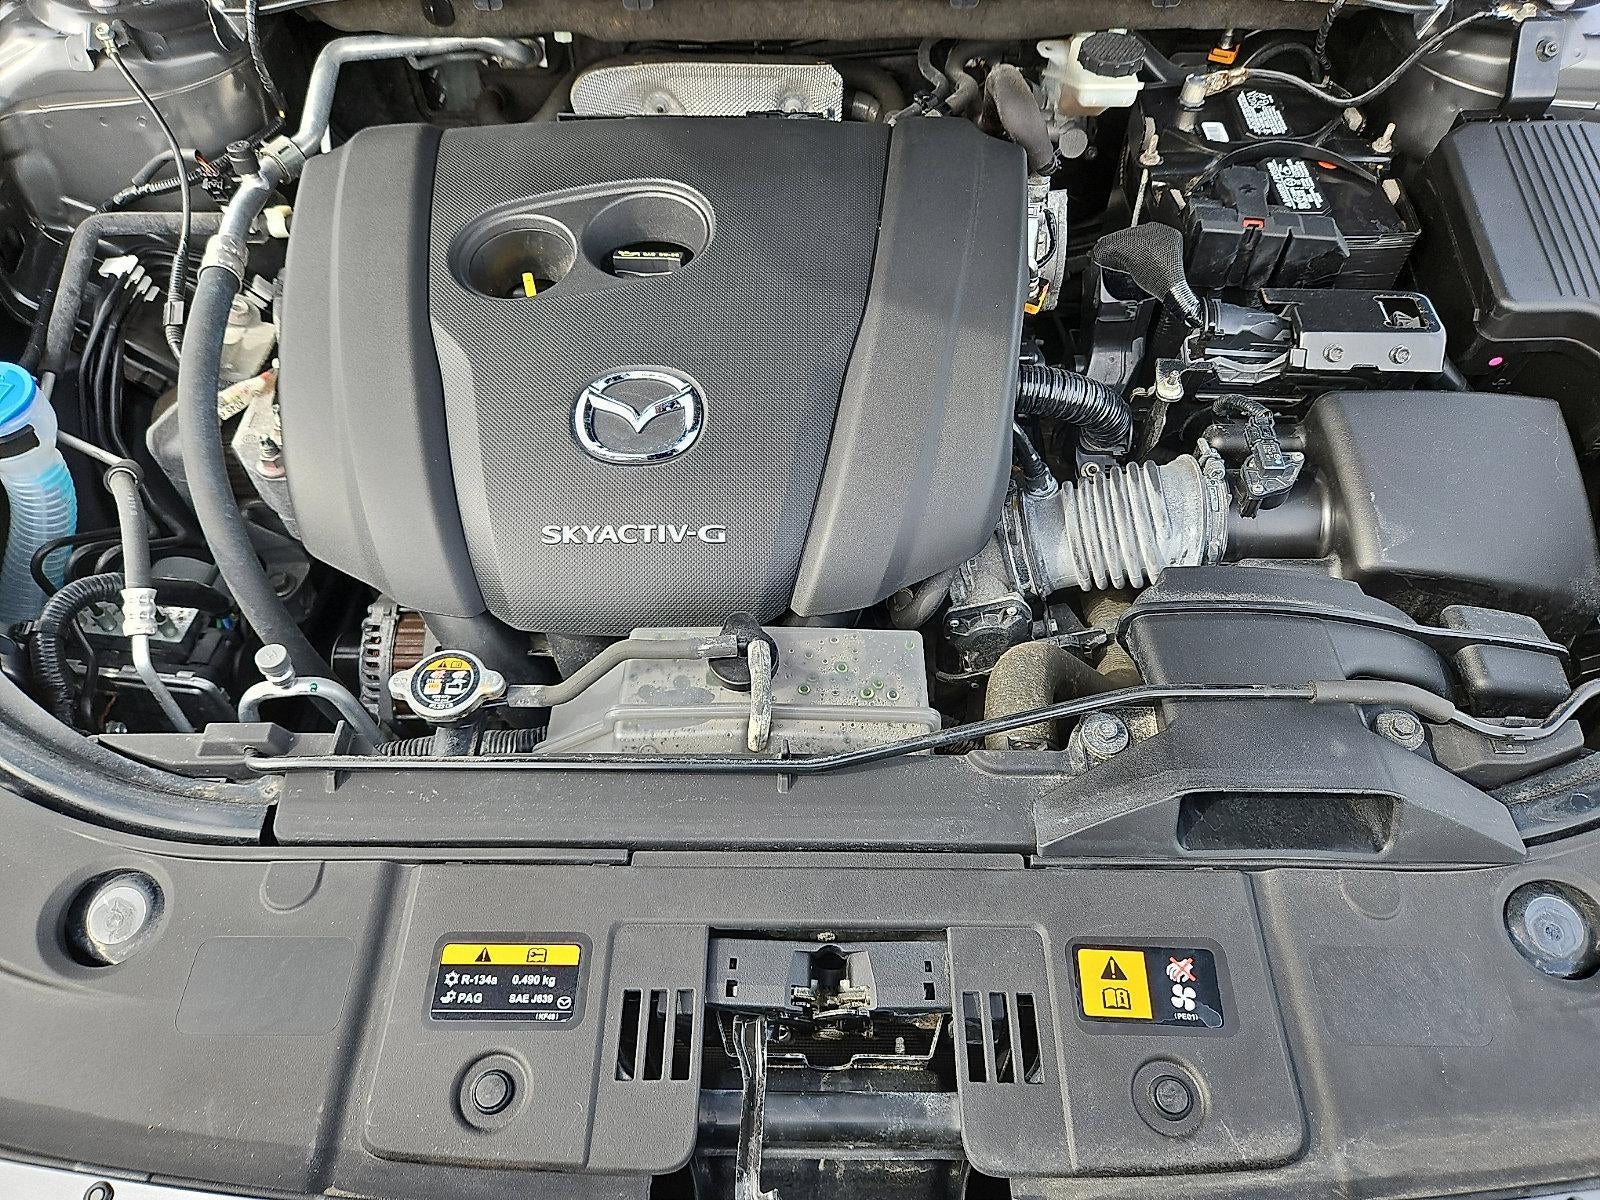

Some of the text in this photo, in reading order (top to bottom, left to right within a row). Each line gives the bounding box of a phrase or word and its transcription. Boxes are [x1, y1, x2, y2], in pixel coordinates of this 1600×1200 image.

[541, 524, 727, 545] SKYACTIV-G
[461, 974, 498, 985] R-134a
[512, 974, 556, 987] 0.490 kg
[457, 993, 483, 1004] PAG
[508, 993, 530, 1004] SAE
